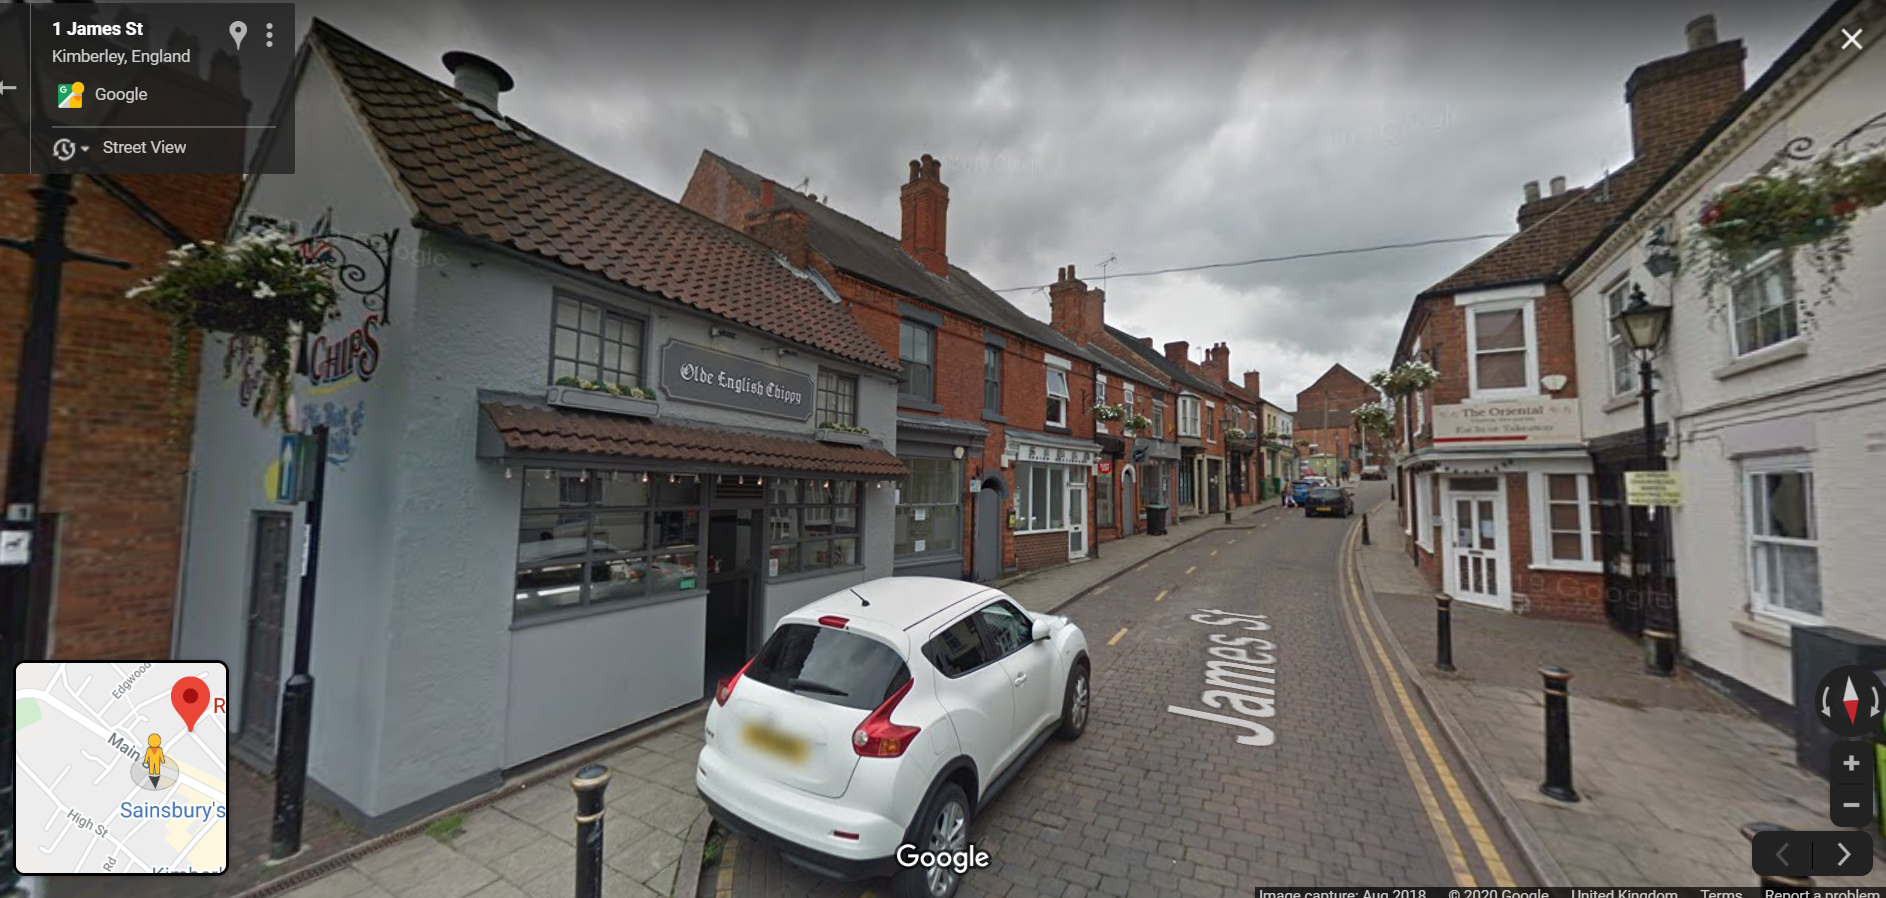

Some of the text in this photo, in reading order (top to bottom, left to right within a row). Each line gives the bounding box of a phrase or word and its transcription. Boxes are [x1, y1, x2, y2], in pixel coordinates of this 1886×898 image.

[310, 315, 379, 384] CHIPS
[680, 363, 802, 405] Olde English Chippy
[1461, 408, 1486, 417] The
[1488, 406, 1544, 417] Oriental
[1502, 424, 1555, 433] Takeaway
[1168, 608, 1278, 746] James St
